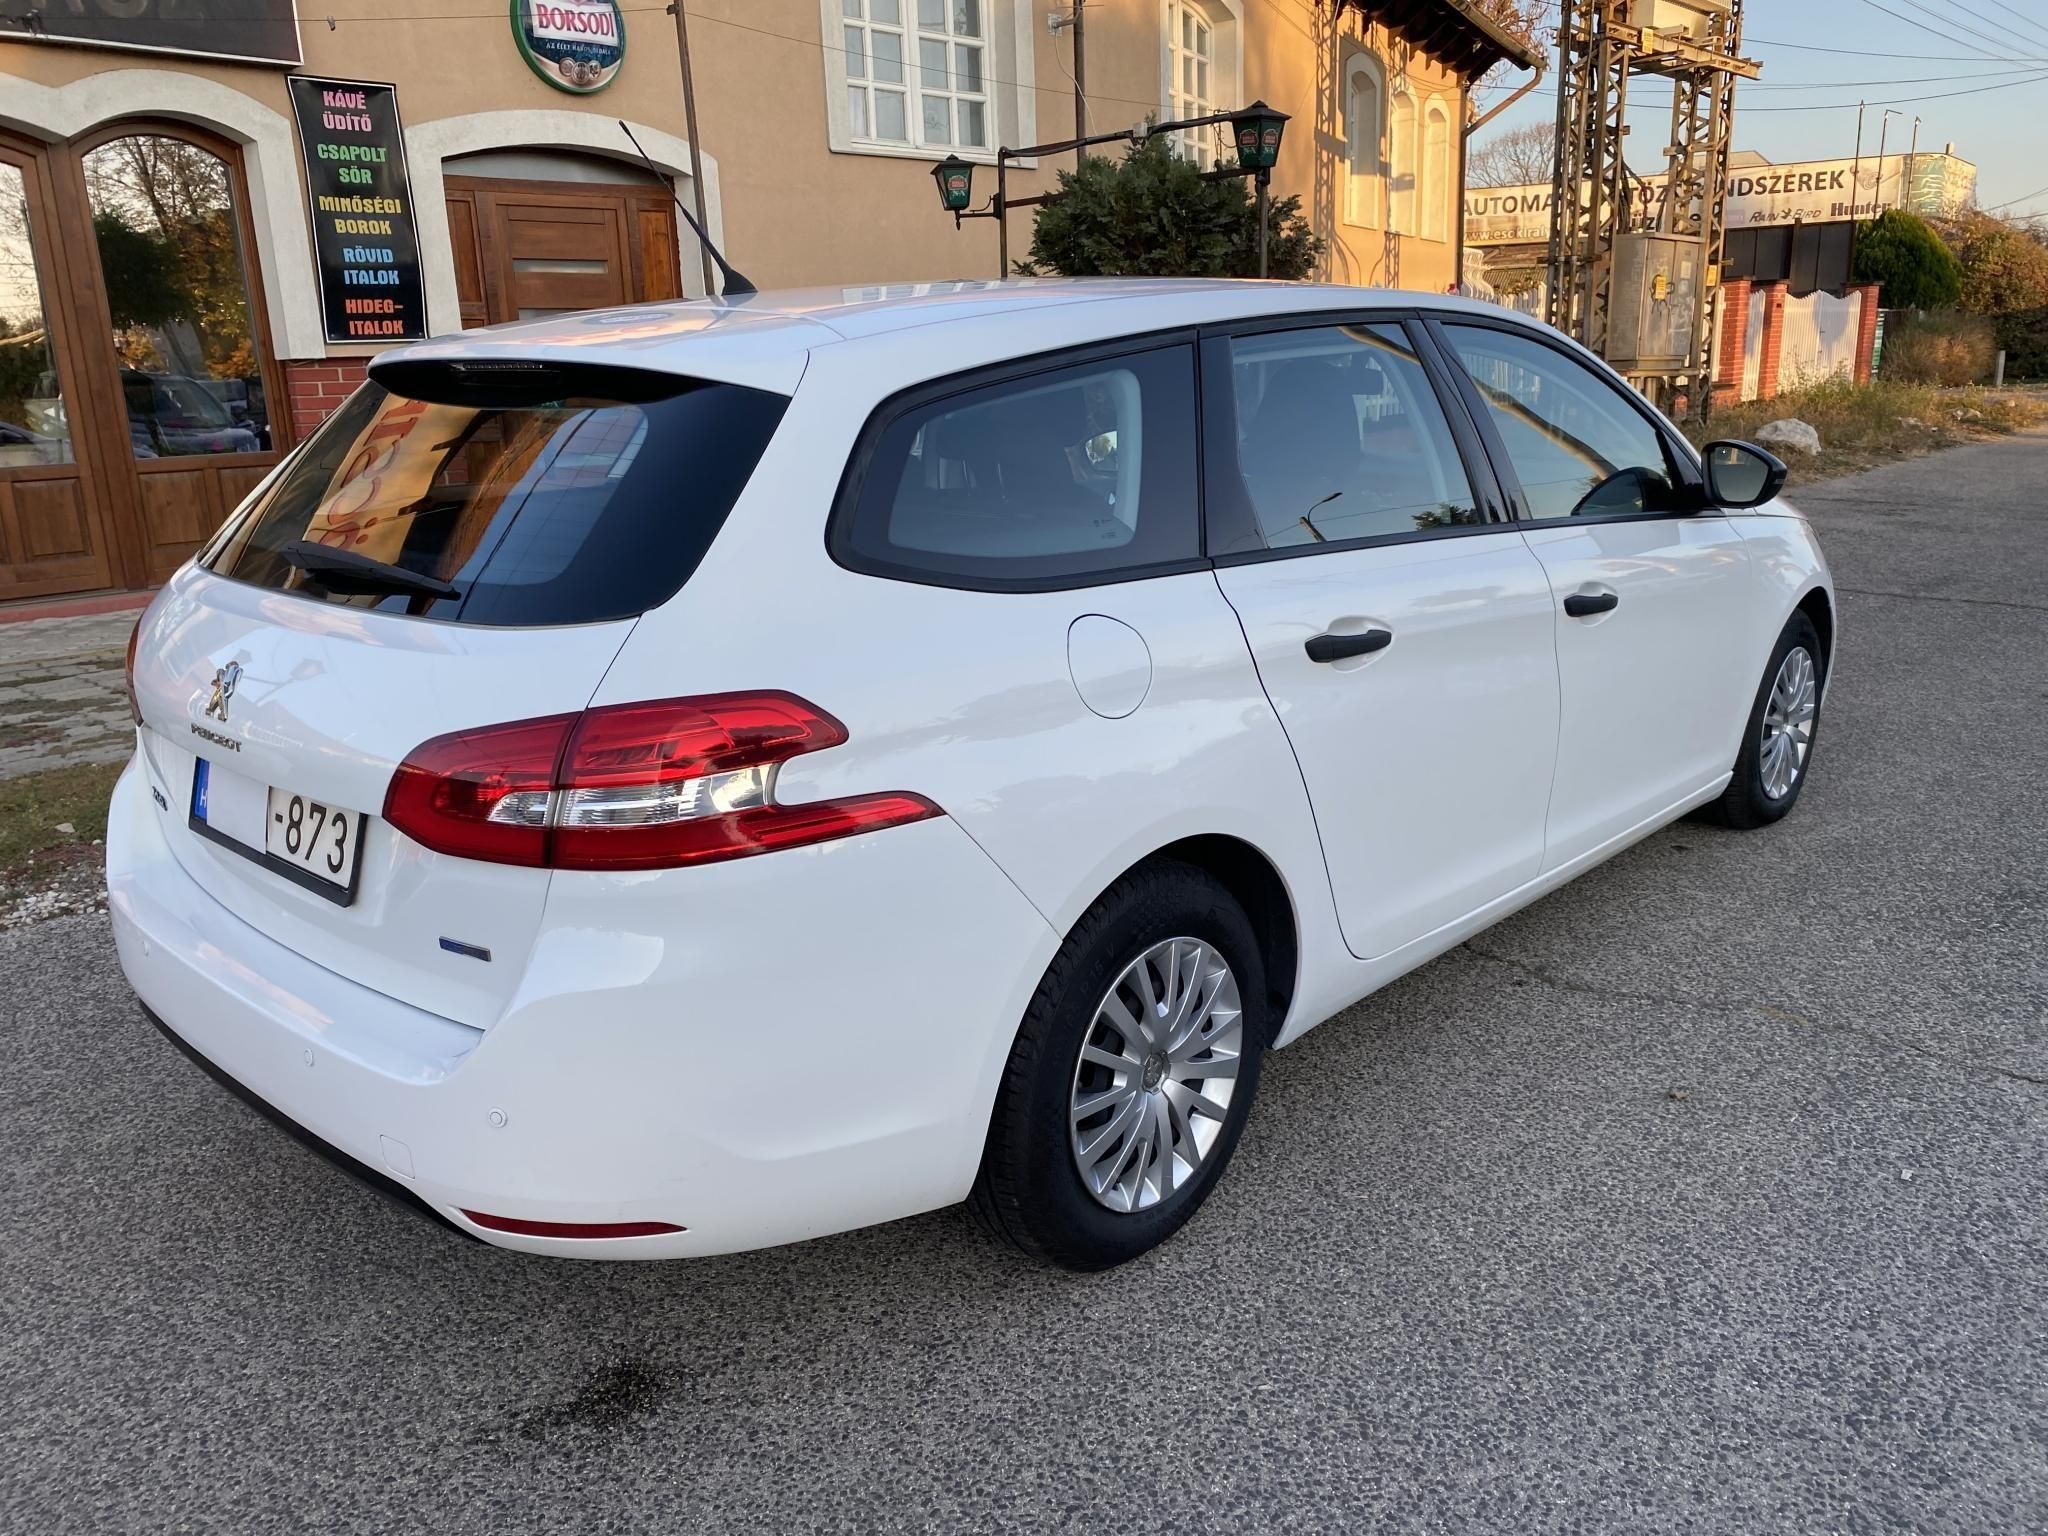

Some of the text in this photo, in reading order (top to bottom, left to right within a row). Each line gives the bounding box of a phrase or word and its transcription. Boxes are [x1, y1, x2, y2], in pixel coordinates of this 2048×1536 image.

[536, 3, 615, 37] BORSODI
[323, 90, 367, 109] KÁVÉ
[317, 143, 387, 162] CSAPOLT
[338, 165, 373, 184] SÖR
[334, 219, 392, 235] BOROK
[342, 245, 394, 263] RÖVID
[343, 270, 400, 285] ITALOK
[349, 320, 404, 335] ITALOK
